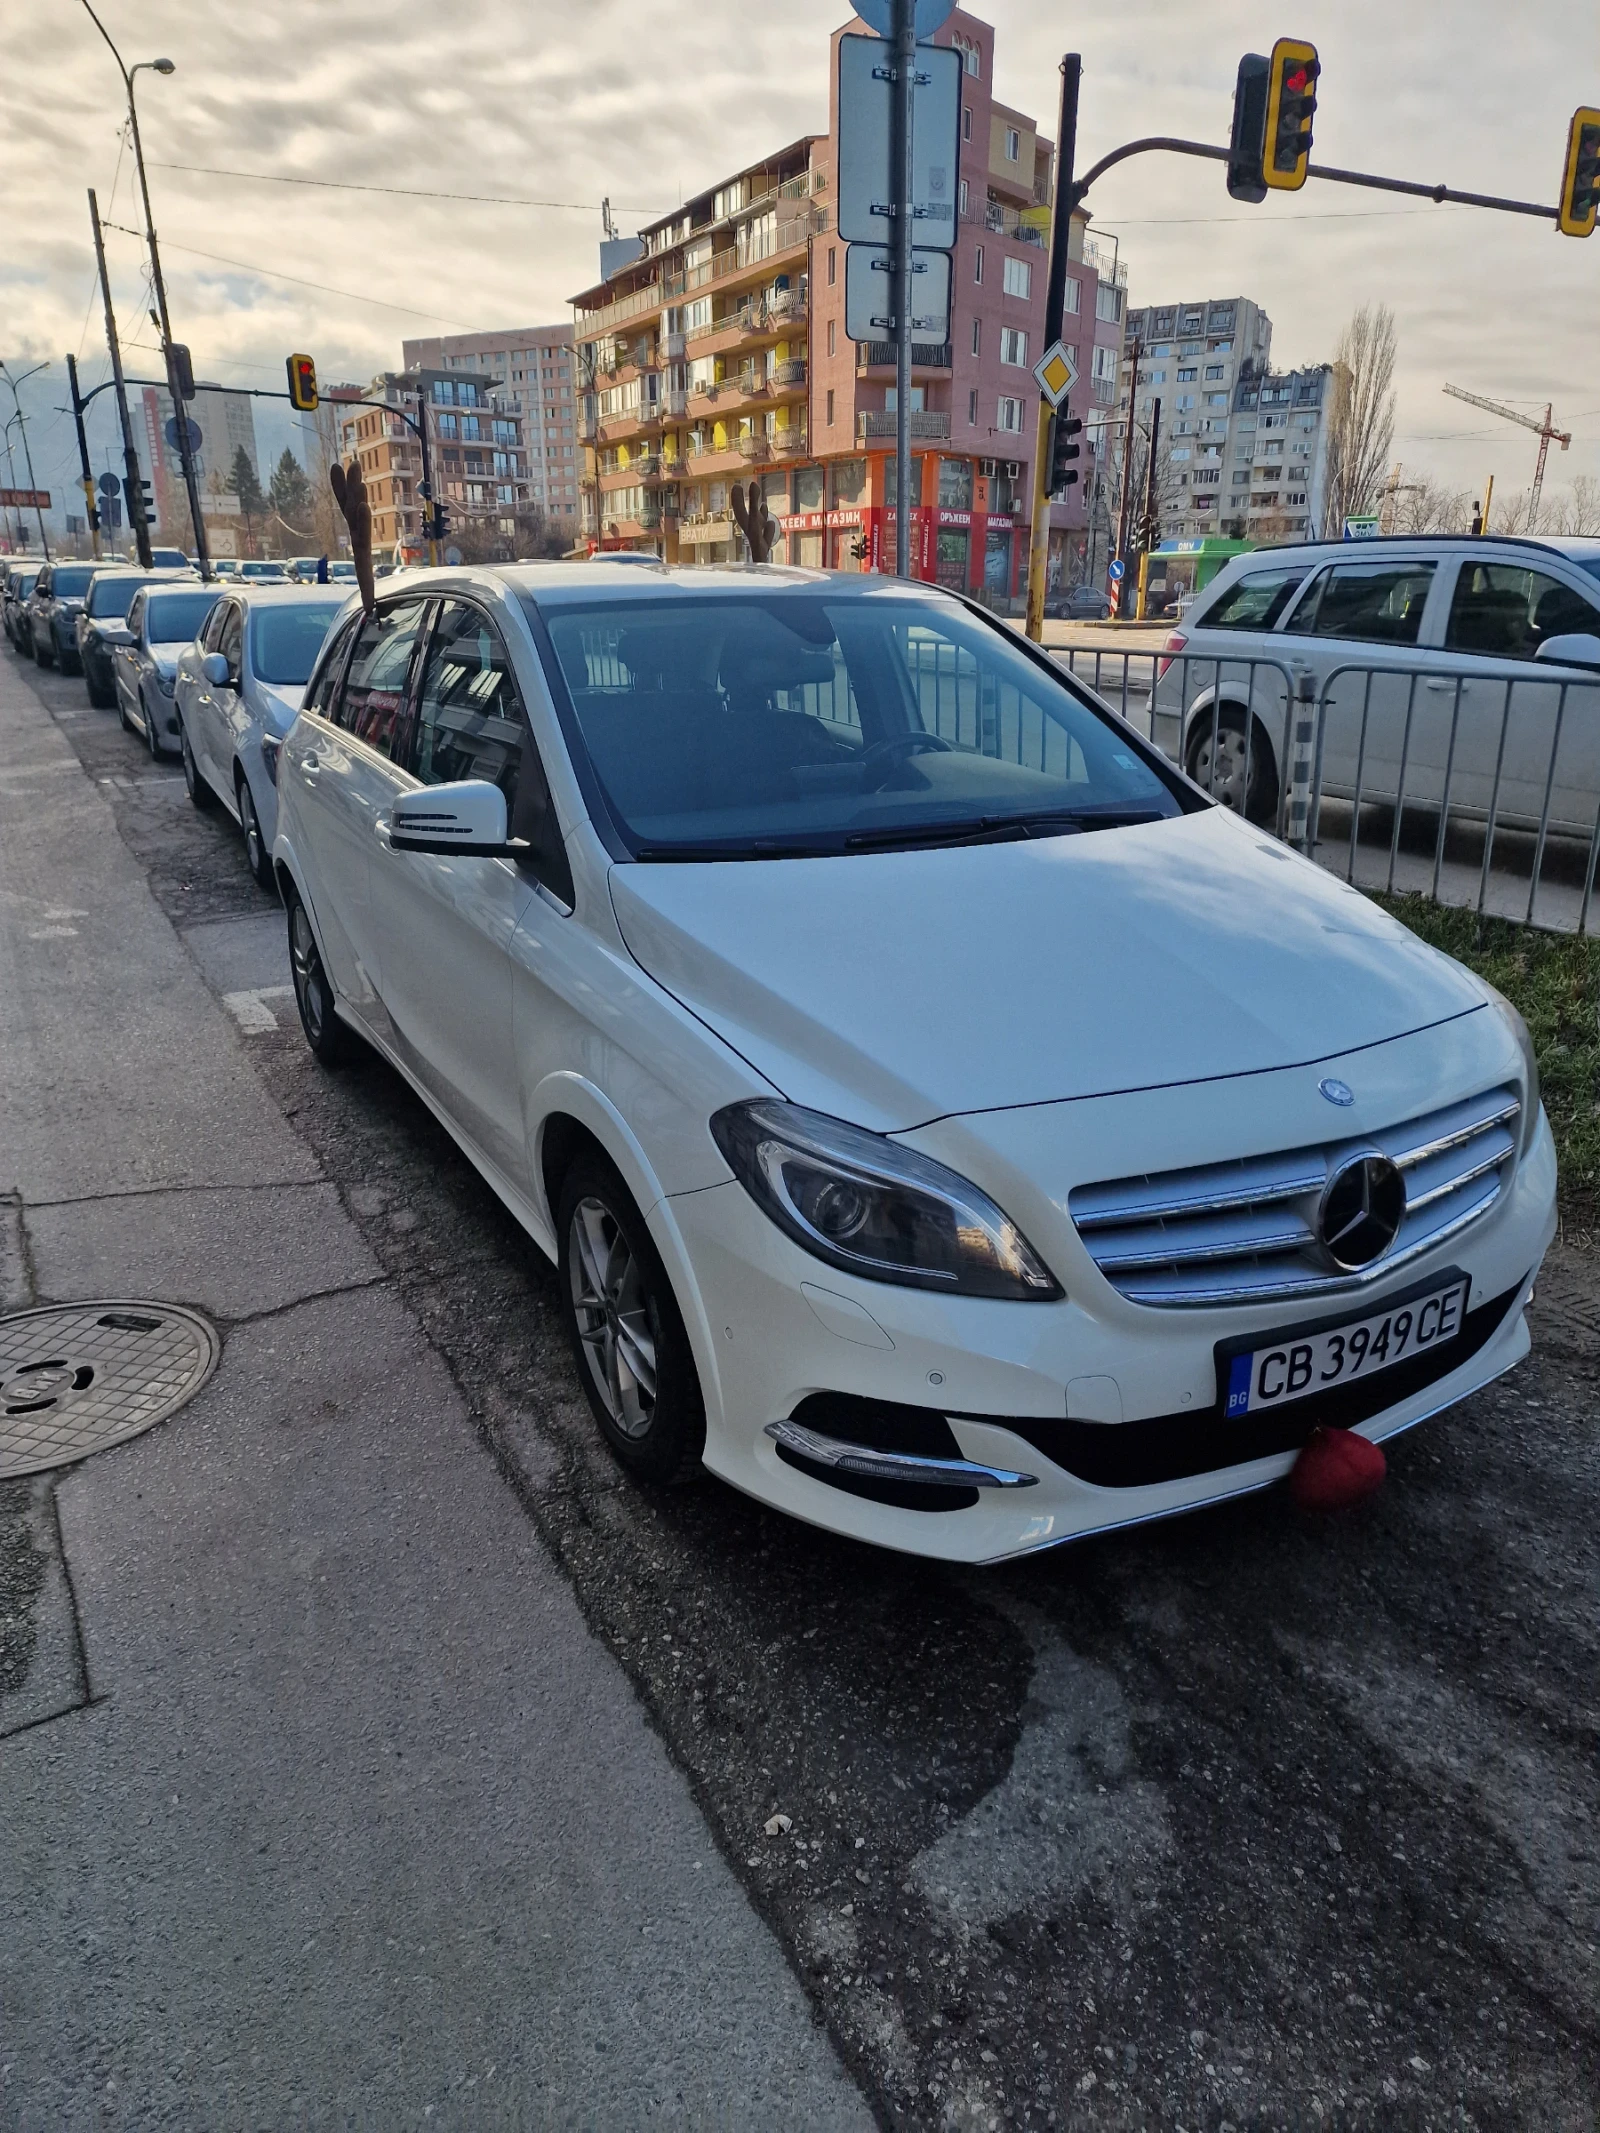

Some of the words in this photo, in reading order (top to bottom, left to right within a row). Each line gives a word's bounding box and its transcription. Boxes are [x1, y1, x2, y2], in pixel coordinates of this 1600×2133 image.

[779, 516, 806, 529] ЖЕЕН
[887, 512, 918, 521] ZAEX
[940, 511, 971, 524] ОРЪЖЕЕН
[987, 516, 1013, 528] МАГАЗИН
[680, 527, 709, 542] ВРАТИ
[1177, 541, 1195, 551] OMV
[1258, 1344, 1313, 1400] CB
[1320, 1310, 1413, 1381] 3949
[1417, 1288, 1461, 1344] CE
[1229, 1391, 1247, 1408] BG
